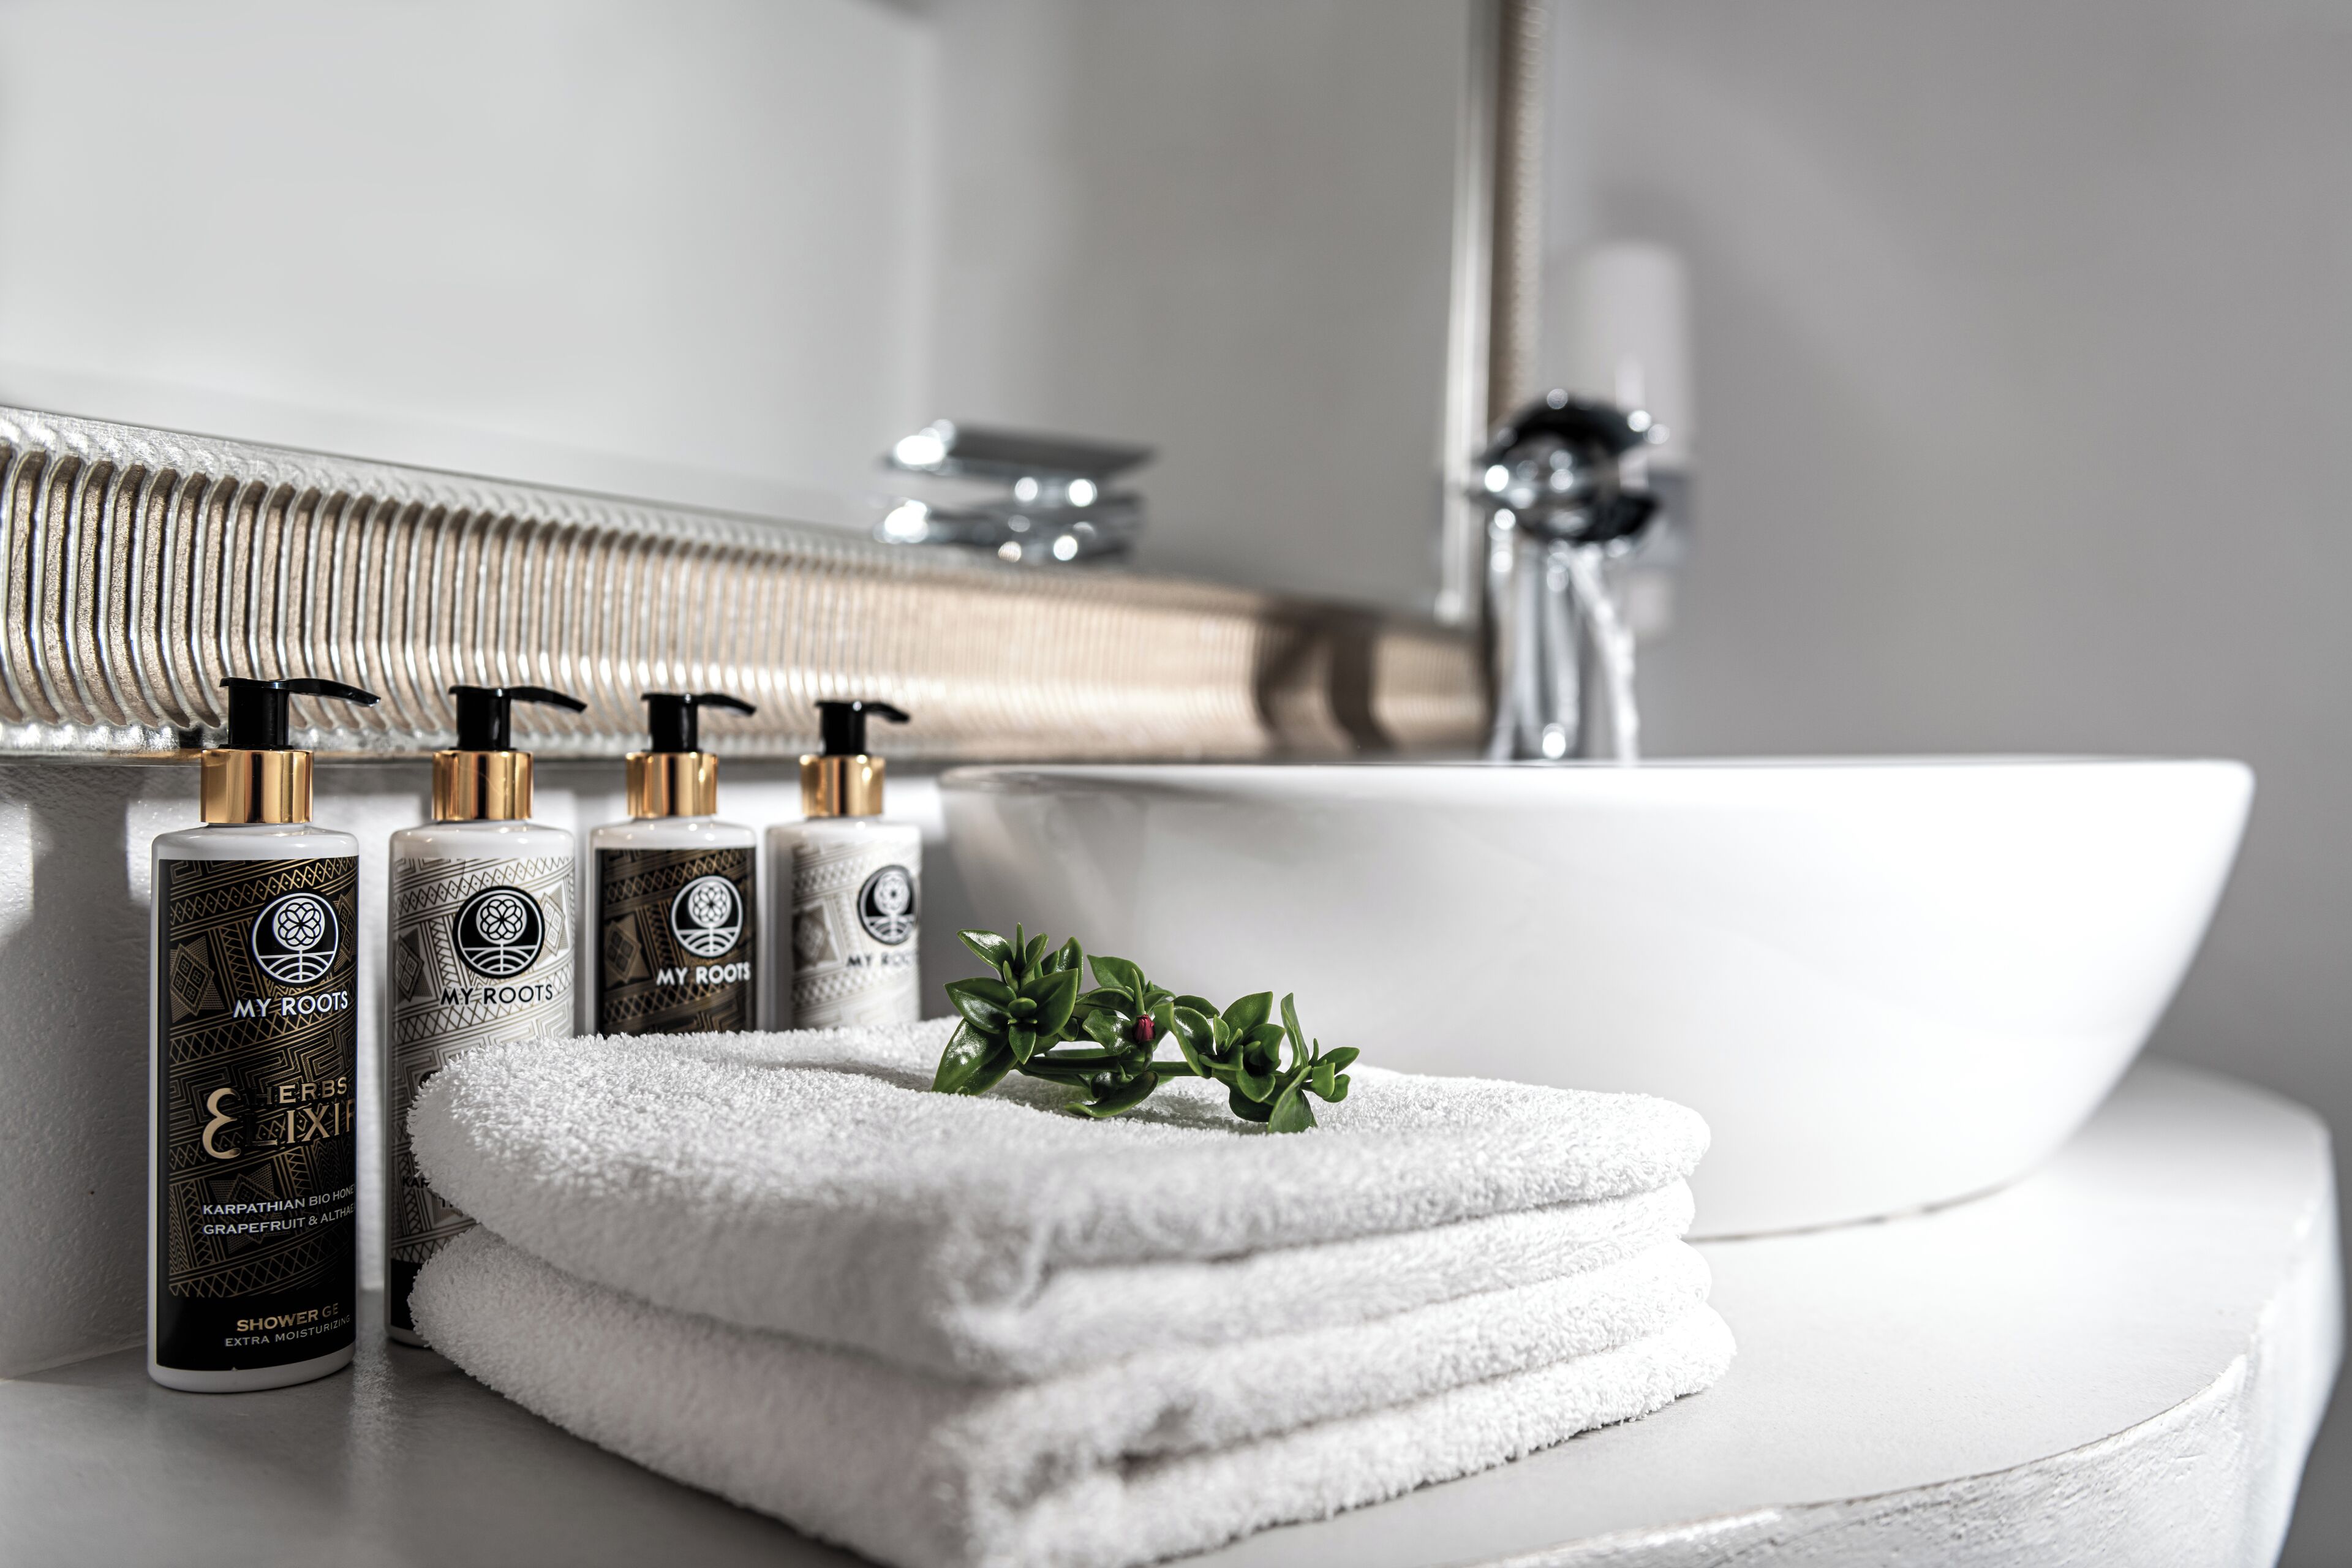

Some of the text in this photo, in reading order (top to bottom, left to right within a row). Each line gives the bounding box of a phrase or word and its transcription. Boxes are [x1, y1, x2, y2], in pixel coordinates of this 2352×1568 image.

[657, 961, 750, 986] MY ROOTS
[846, 954, 873, 968] MY
[233, 990, 349, 1018] MY ROOTS
[440, 984, 553, 1005] MY ROOTS
[203, 1183, 356, 1215] KARPATHIAN BIO HONE
[203, 1202, 356, 1235] GRAPEFRUIT & ALTHAE
[224, 1314, 351, 1347] EXTRA MOISTURIZING
[236, 1302, 339, 1332] SHOWER GE
